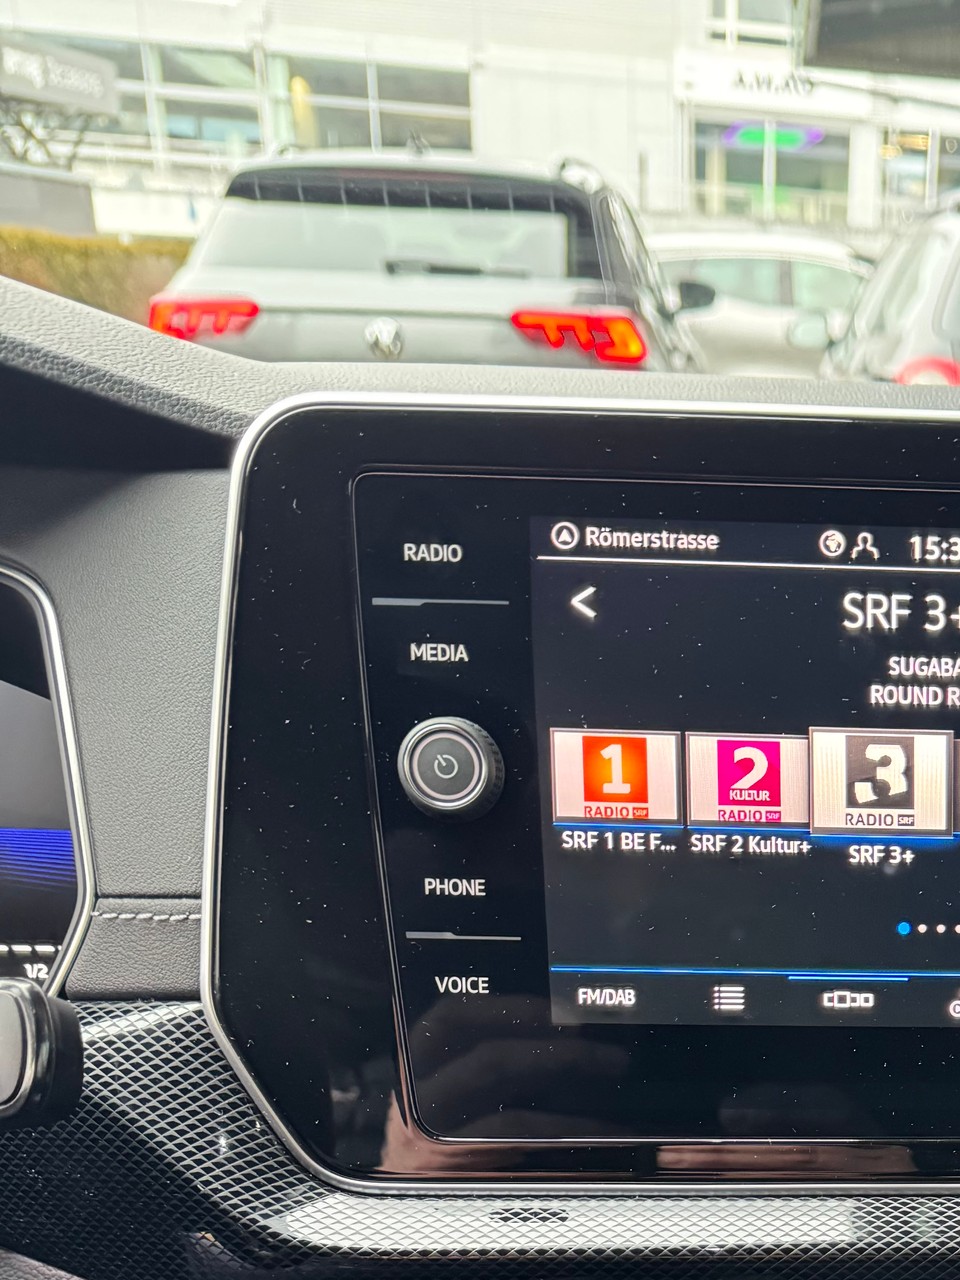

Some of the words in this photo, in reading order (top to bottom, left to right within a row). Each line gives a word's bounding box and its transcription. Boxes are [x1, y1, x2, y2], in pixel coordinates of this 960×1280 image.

[585, 524, 720, 551] Römerstrasse
[403, 542, 464, 564] RADIO
[842, 592, 914, 632] SRF
[409, 643, 469, 664] MEDIA
[869, 684, 944, 708] ROUND
[600, 743, 631, 794] 1
[730, 746, 768, 790] 2
[854, 743, 909, 804] 3
[729, 788, 771, 802] KULTUR
[584, 805, 630, 820] RADIO
[718, 809, 763, 822] RADIO
[845, 813, 894, 828] RADIO
[897, 815, 915, 827] SRF
[561, 831, 599, 850] SRF
[604, 832, 614, 850] 1
[621, 832, 645, 851] BE
[691, 834, 727, 853] SRF
[731, 836, 744, 854] 2
[749, 836, 812, 856] Kultur+
[849, 844, 886, 864] SRF
[889, 847, 916, 865] 3+
[424, 878, 486, 897] PHONE
[435, 976, 490, 994] VOICE
[577, 986, 637, 1007] FM/DAB
